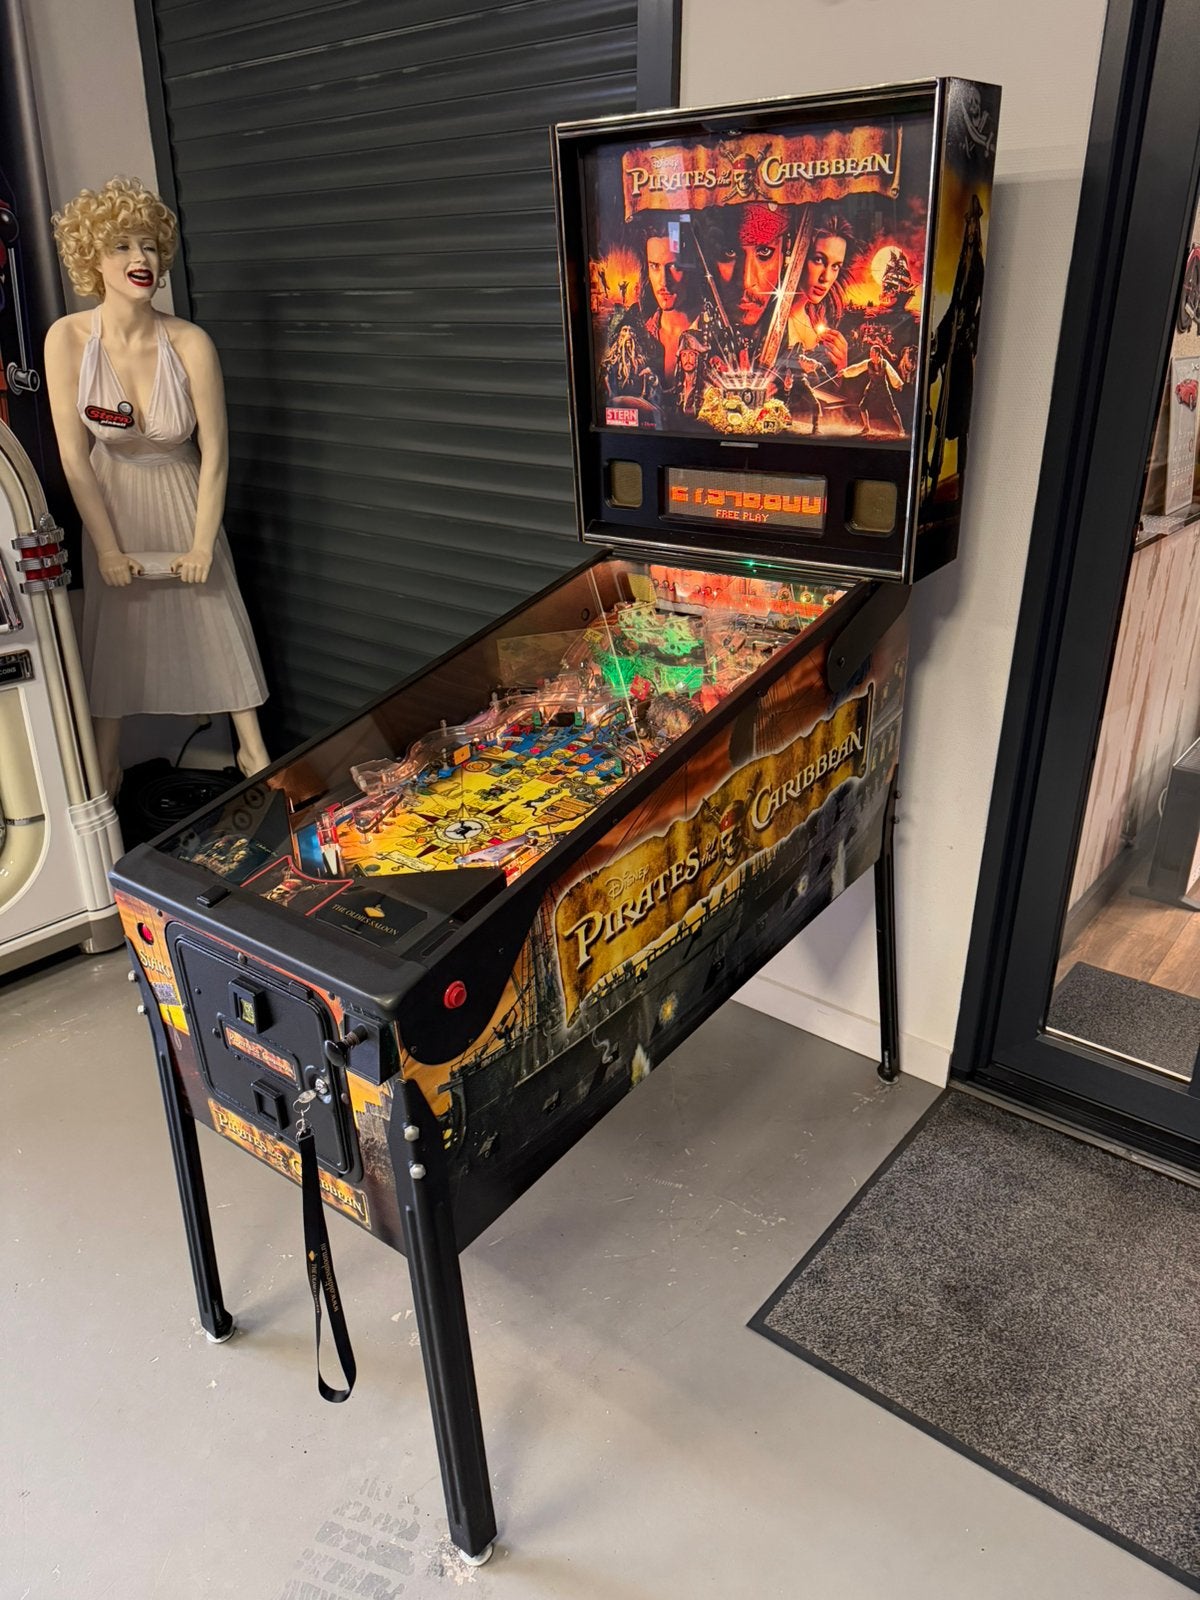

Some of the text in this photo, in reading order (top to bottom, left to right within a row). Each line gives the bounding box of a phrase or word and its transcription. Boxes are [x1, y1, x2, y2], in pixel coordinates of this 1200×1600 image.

[626, 167, 716, 195] PIRATES
[761, 152, 893, 186] CARIBBEAN
[90, 410, 130, 422] Stern
[607, 409, 637, 421] STERN
[715, 509, 769, 522] FREE PLAY
[562, 726, 863, 970] PIRATES of the CARIBBEAN
[331, 903, 400, 936] THE OLDIES SALOON
[213, 1107, 365, 1216] PIRATES CBBEAN
